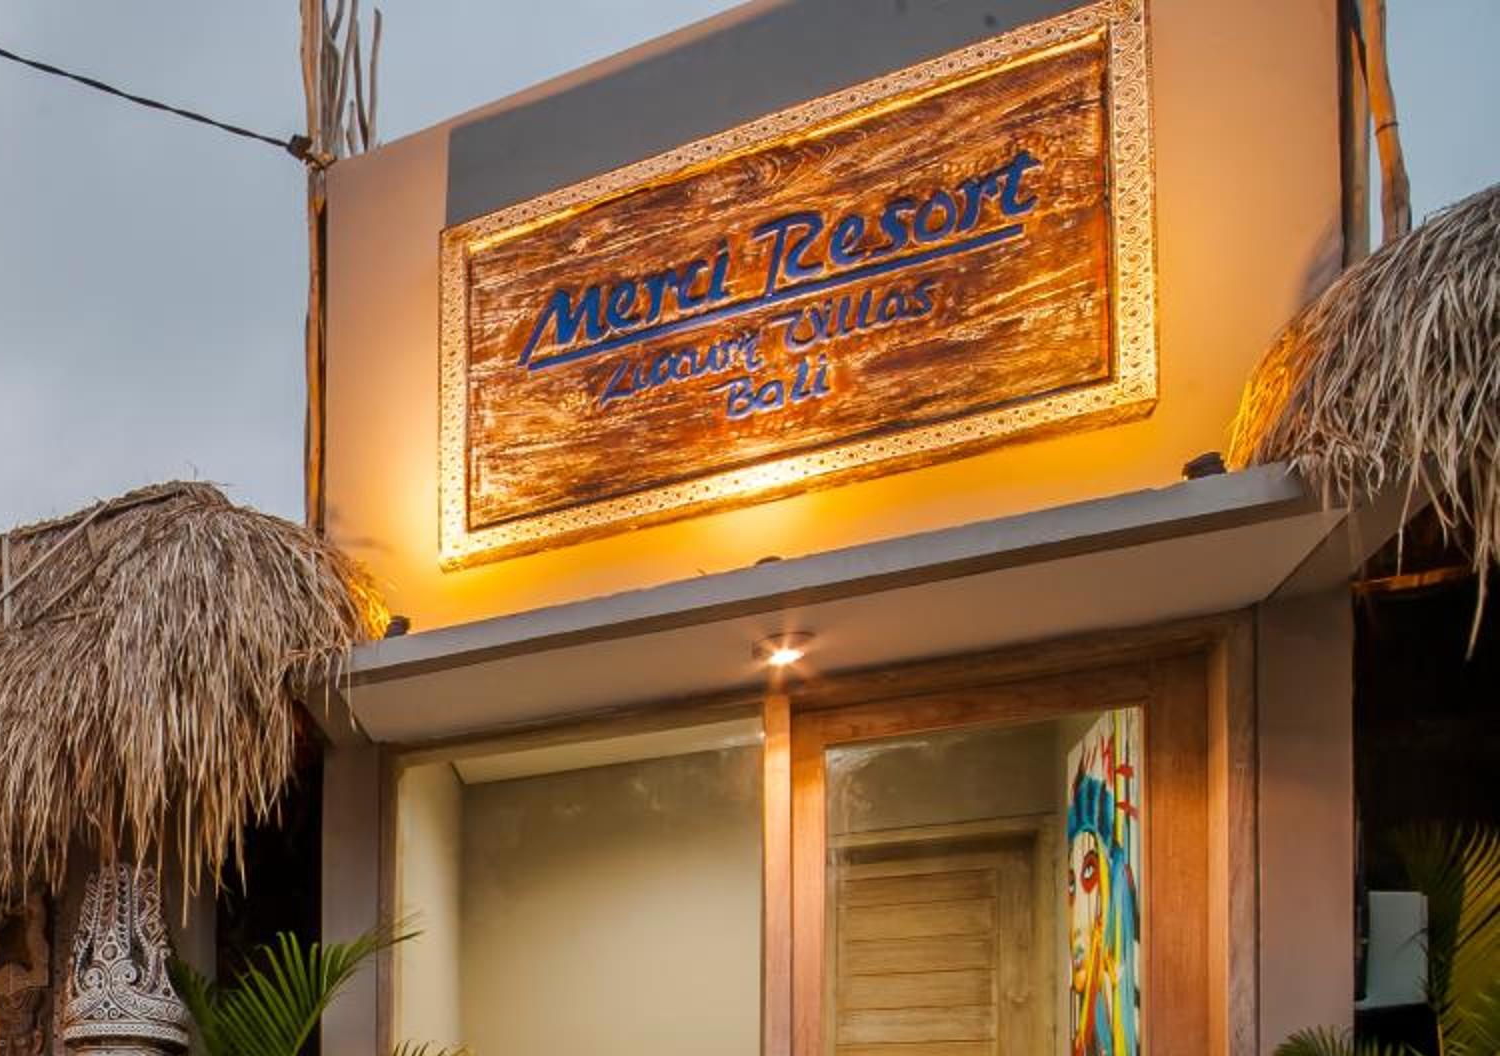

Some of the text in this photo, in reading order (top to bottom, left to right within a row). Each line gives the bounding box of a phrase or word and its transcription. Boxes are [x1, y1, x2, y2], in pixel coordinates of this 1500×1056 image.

[518, 150, 1042, 368] Merci Resort
[708, 353, 831, 421] Bali
